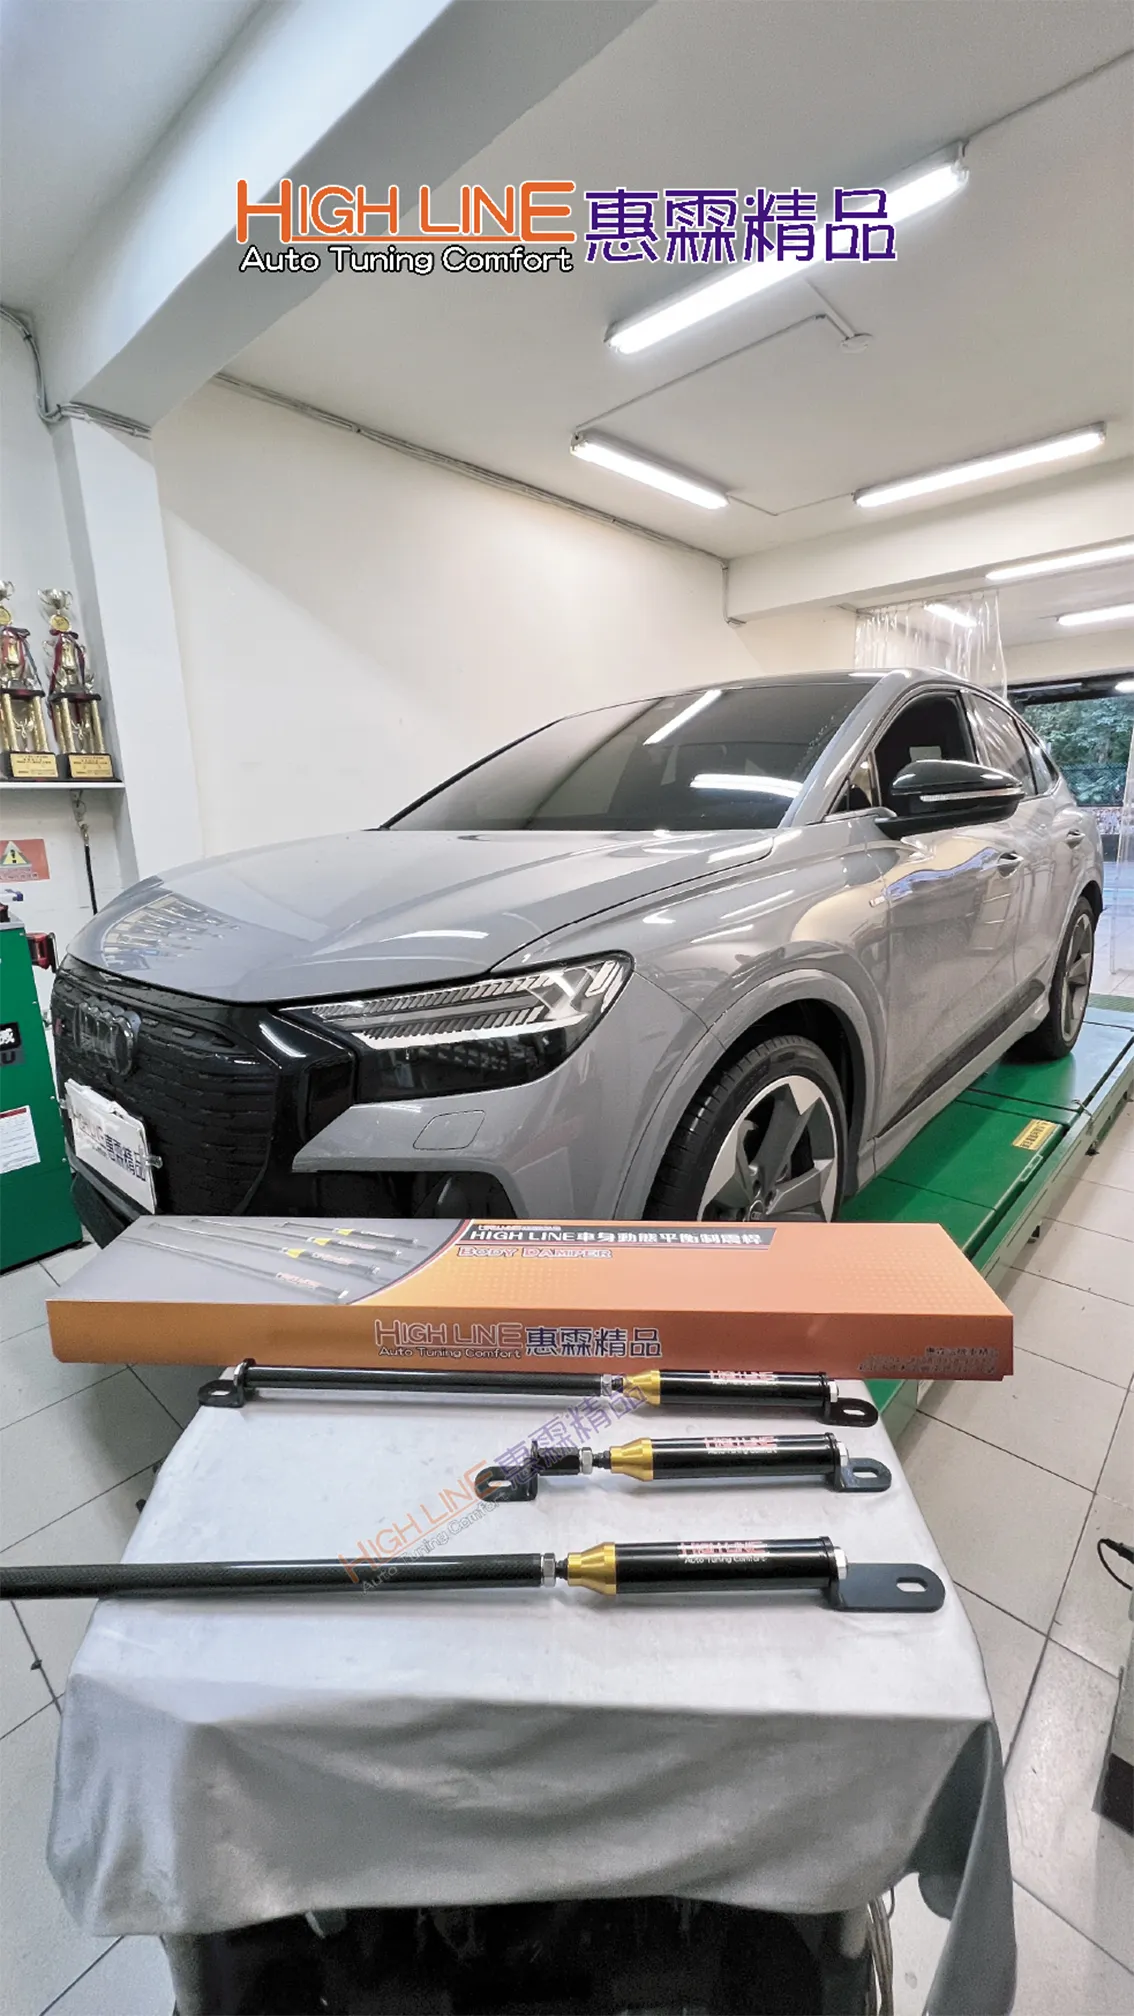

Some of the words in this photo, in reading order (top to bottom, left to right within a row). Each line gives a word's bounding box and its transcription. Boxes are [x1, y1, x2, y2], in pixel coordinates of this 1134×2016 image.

[470, 1230, 526, 1241] HIGH
[458, 1246, 518, 1258] BODY
[521, 1247, 613, 1259] DAMPER
[375, 1319, 447, 1347] HIGH
[453, 1322, 524, 1349] LINE
[525, 1326, 663, 1358] 惠霖精品
[379, 1346, 413, 1357] Auto
[418, 1346, 461, 1359] Tuning
[465, 1347, 521, 1359] Comfort
[684, 1555, 704, 1564] Auto
[707, 1555, 732, 1564] Tuning
